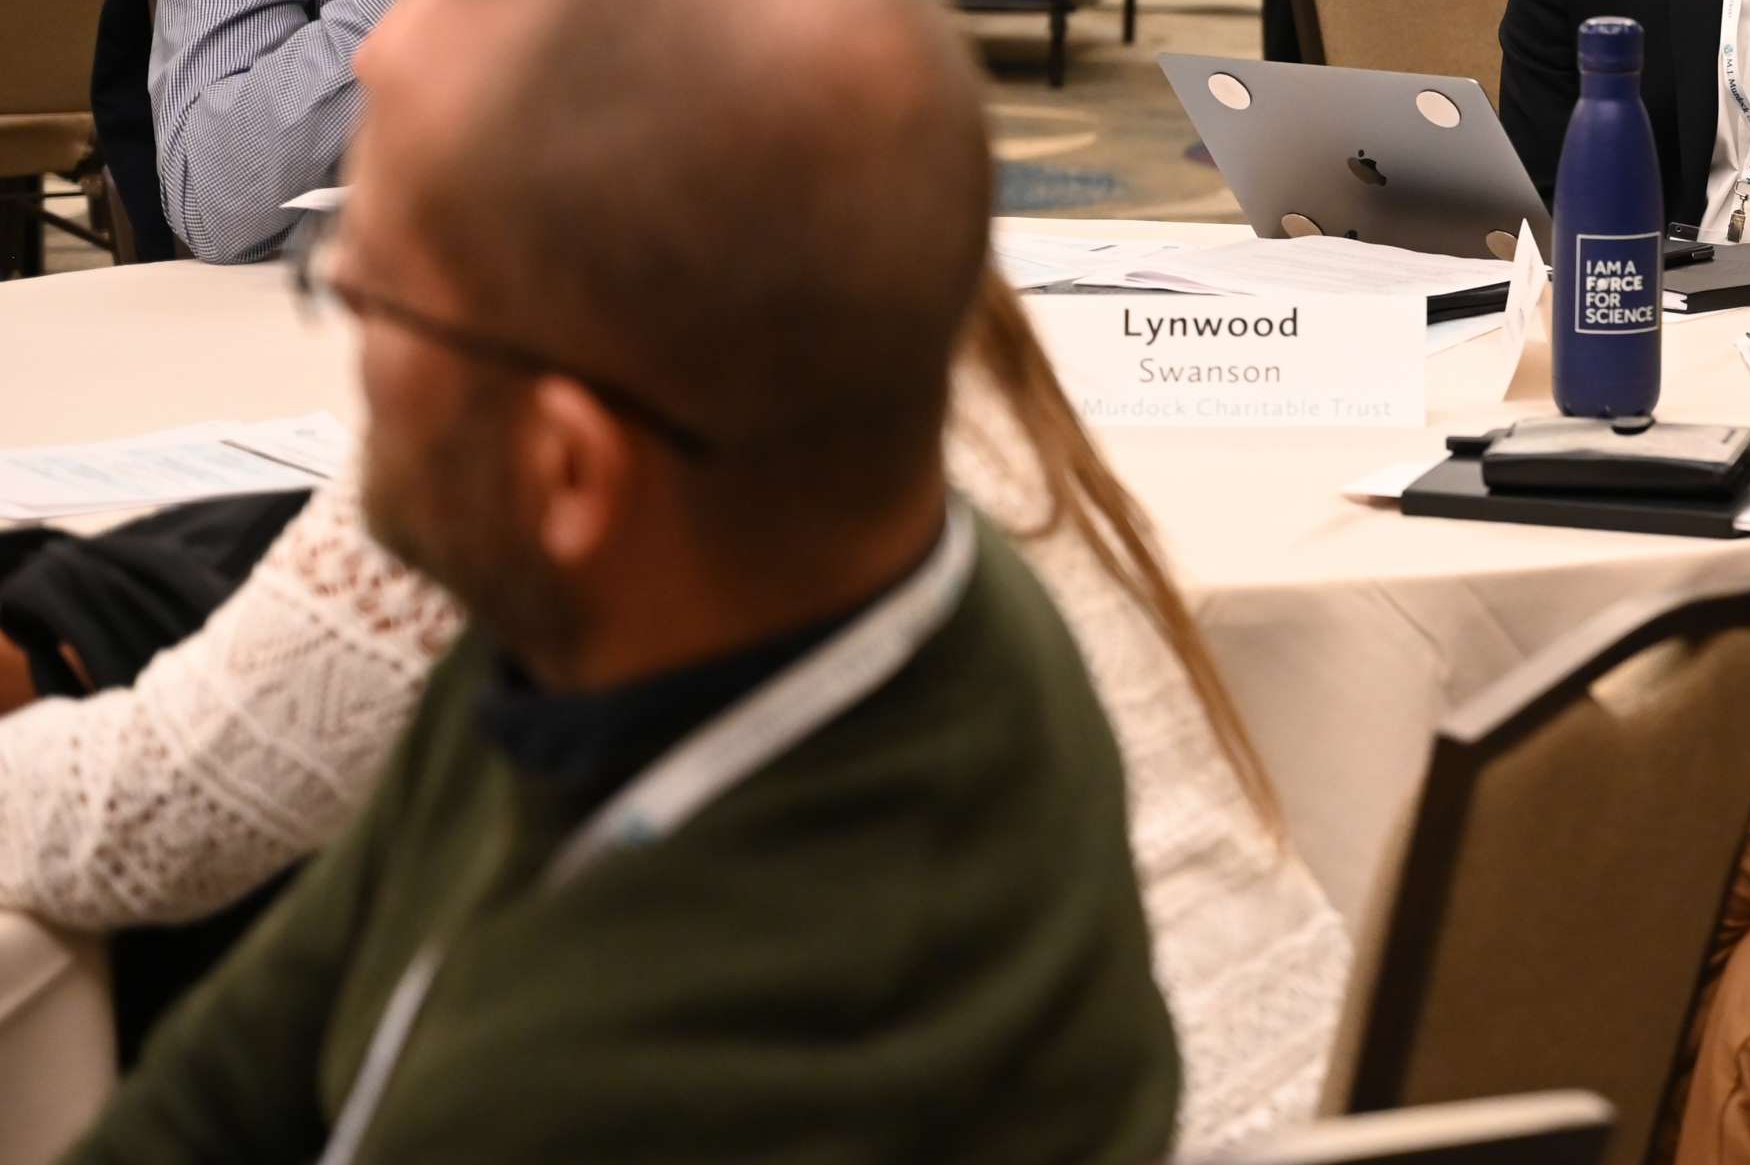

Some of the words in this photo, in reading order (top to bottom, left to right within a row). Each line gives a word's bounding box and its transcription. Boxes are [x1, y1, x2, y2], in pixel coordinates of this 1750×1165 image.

[1728, 78, 1750, 114] Murdock
[1586, 260, 1592, 275] I
[1594, 260, 1622, 275] AM
[1624, 260, 1637, 275] A
[1585, 275, 1643, 292] FORCE
[1585, 292, 1621, 307] FOR
[1585, 306, 1654, 324] SCIENCE
[1122, 307, 1300, 345] Lynwood
[1138, 357, 1282, 384] Swanson
[1082, 396, 1186, 418] Murdock
[1195, 396, 1321, 418] Charitable
[1329, 396, 1393, 418] Trust
